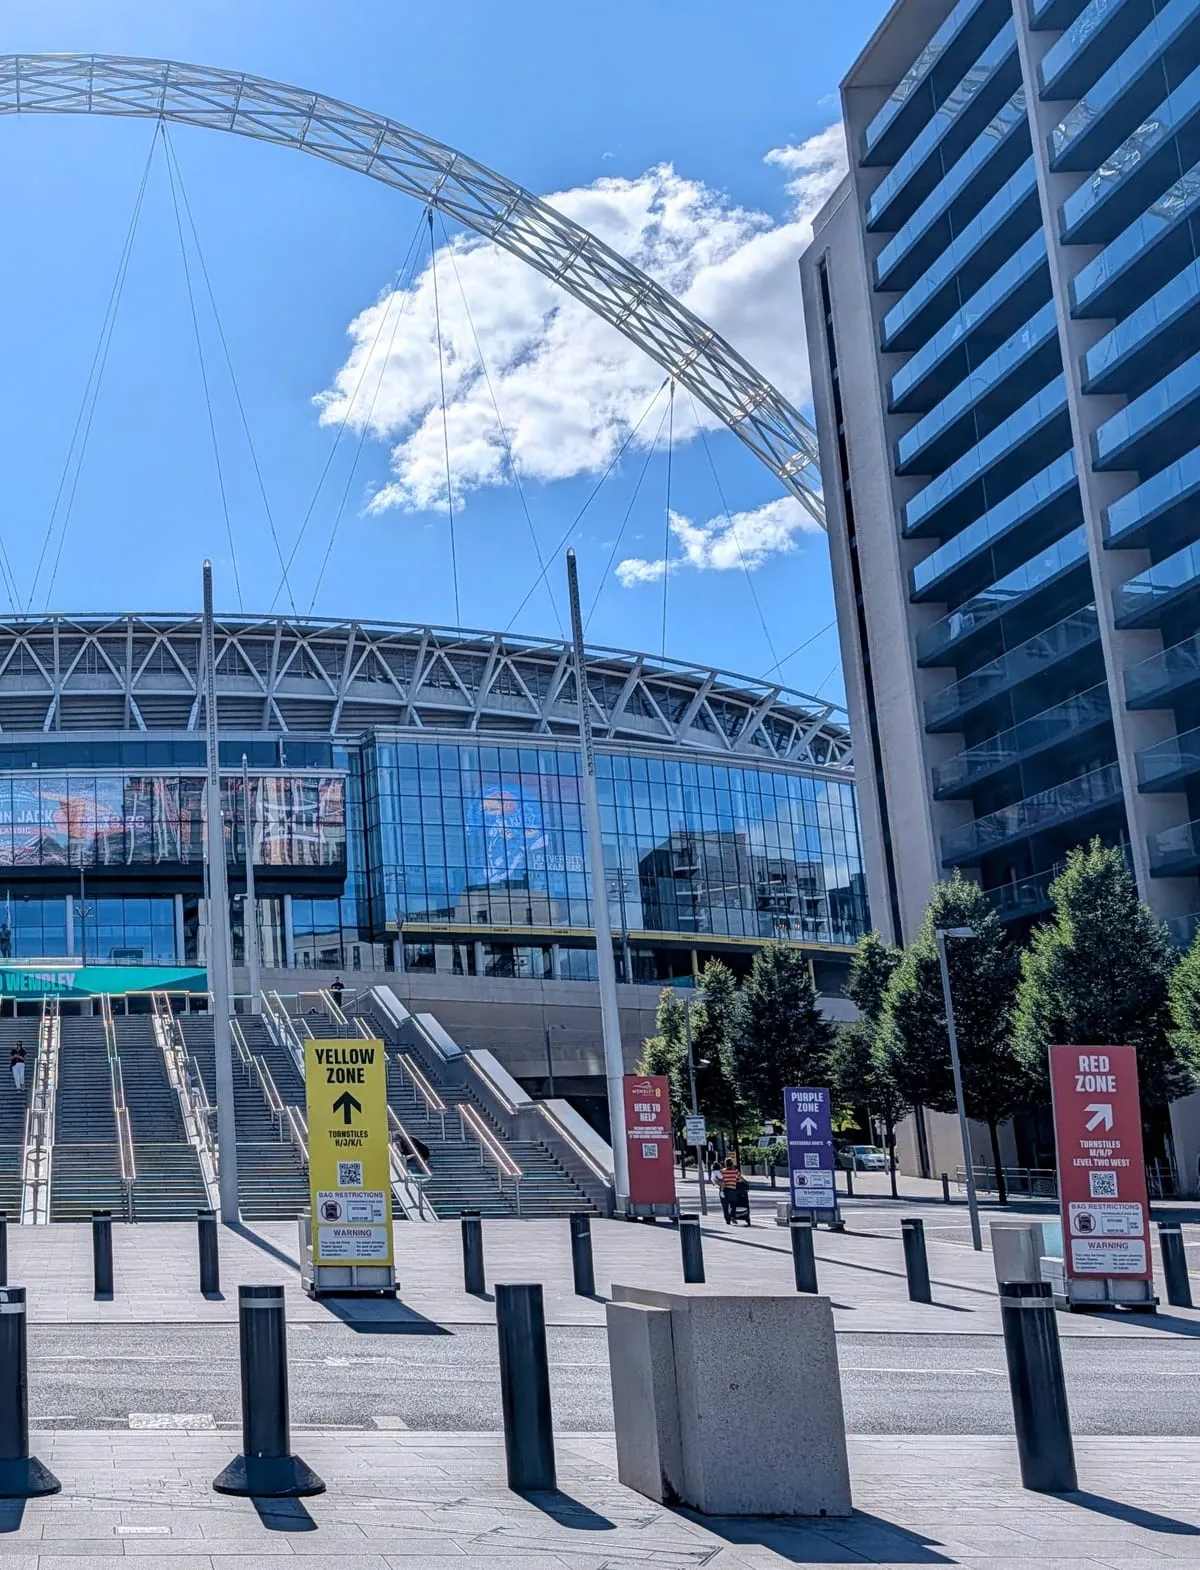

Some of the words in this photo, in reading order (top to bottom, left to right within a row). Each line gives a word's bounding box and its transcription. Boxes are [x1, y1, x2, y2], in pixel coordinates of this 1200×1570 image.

[17, 810, 55, 827] JACK
[533, 854, 586, 864] UNIVERSITY
[5, 973, 75, 991] WEMBLEY
[315, 1048, 375, 1065] YELLOW
[1078, 1055, 1110, 1073] RED
[326, 1067, 365, 1084] ZONE
[1074, 1075, 1117, 1092] ZONE
[791, 1092, 824, 1102] PURPLE
[634, 1103, 651, 1112] HERE
[652, 1103, 661, 1112] TO
[797, 1103, 820, 1112] ZONE
[640, 1112, 657, 1121] HELP
[328, 1130, 369, 1138] TURNSTILES
[335, 1139, 363, 1147] H/J/K/L
[1080, 1140, 1121, 1149] TURNSTILES
[1073, 1158, 1093, 1167] LEVEL
[1094, 1158, 1110, 1167] TWO
[1110, 1158, 1130, 1167] WEST
[1088, 1203, 1140, 1211] RESTRICTIONS
[333, 1229, 373, 1237] WARNING
[1088, 1242, 1129, 1250] WARNING
